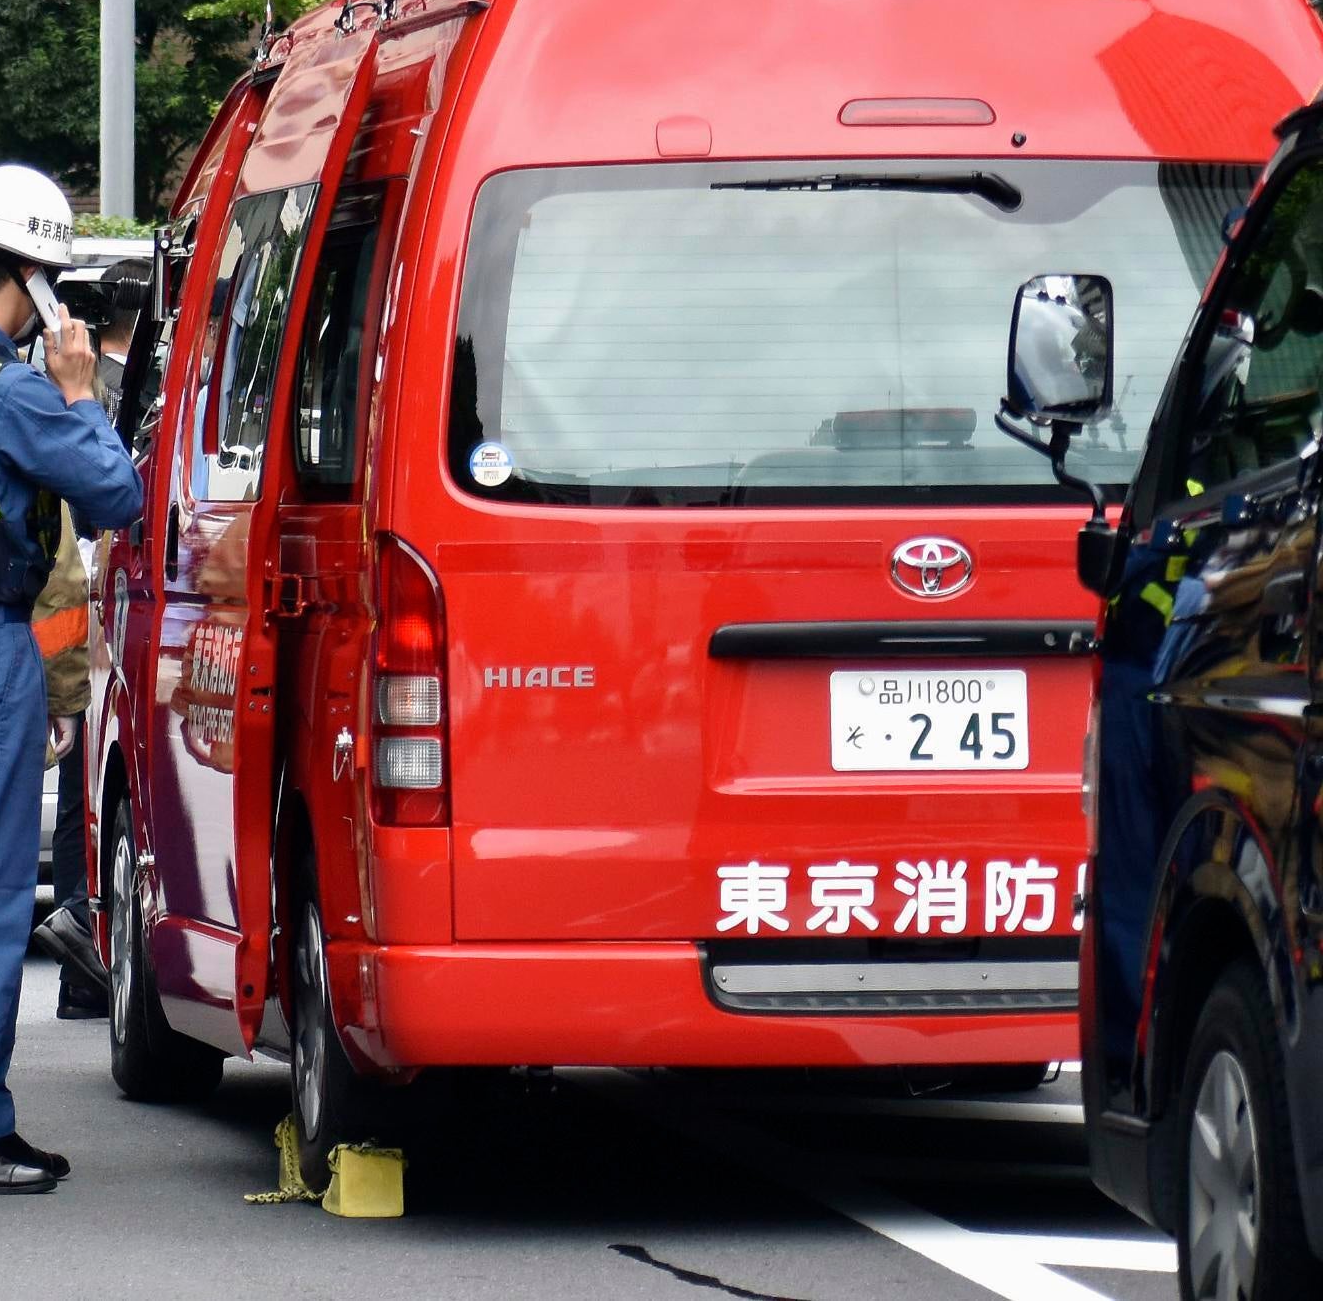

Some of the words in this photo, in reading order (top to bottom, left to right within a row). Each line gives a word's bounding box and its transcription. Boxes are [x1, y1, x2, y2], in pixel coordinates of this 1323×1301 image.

[26, 216, 75, 245] 東京消防
[484, 667, 595, 688] HIACE
